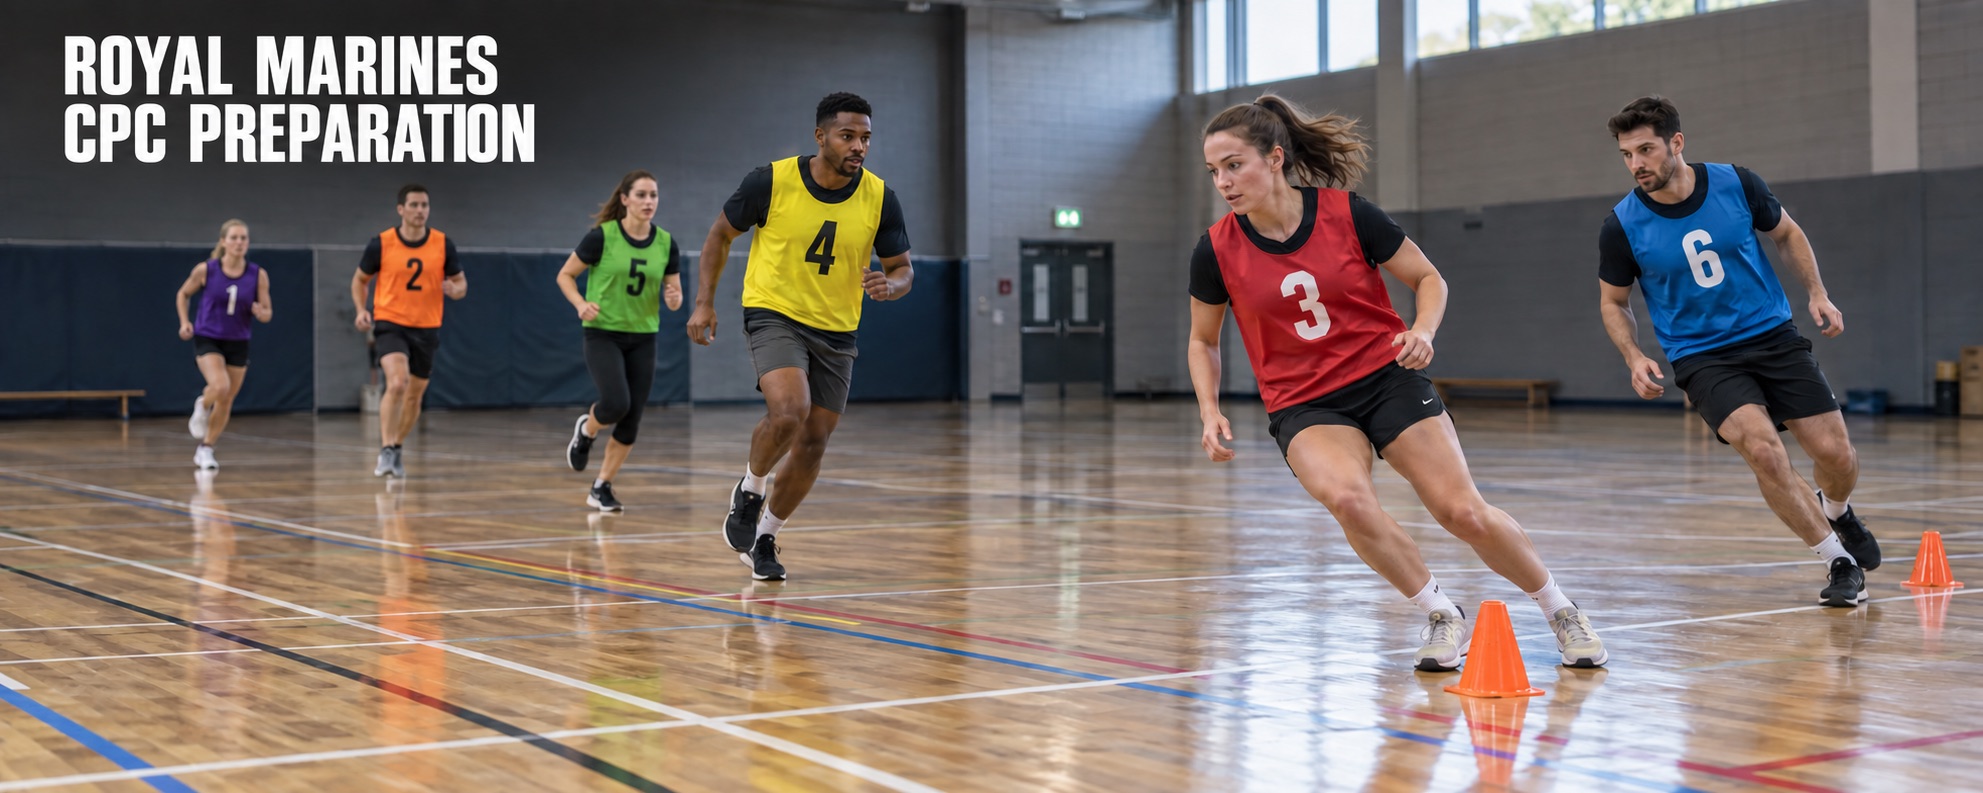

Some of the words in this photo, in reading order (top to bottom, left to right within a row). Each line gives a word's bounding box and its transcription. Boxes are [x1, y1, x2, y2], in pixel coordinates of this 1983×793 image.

[804, 220, 838, 276] 4
[1681, 229, 1725, 289] 6
[406, 258, 423, 291] 2
[626, 258, 647, 297] 5
[226, 284, 238, 316] 1
[1280, 270, 1331, 341] 3
